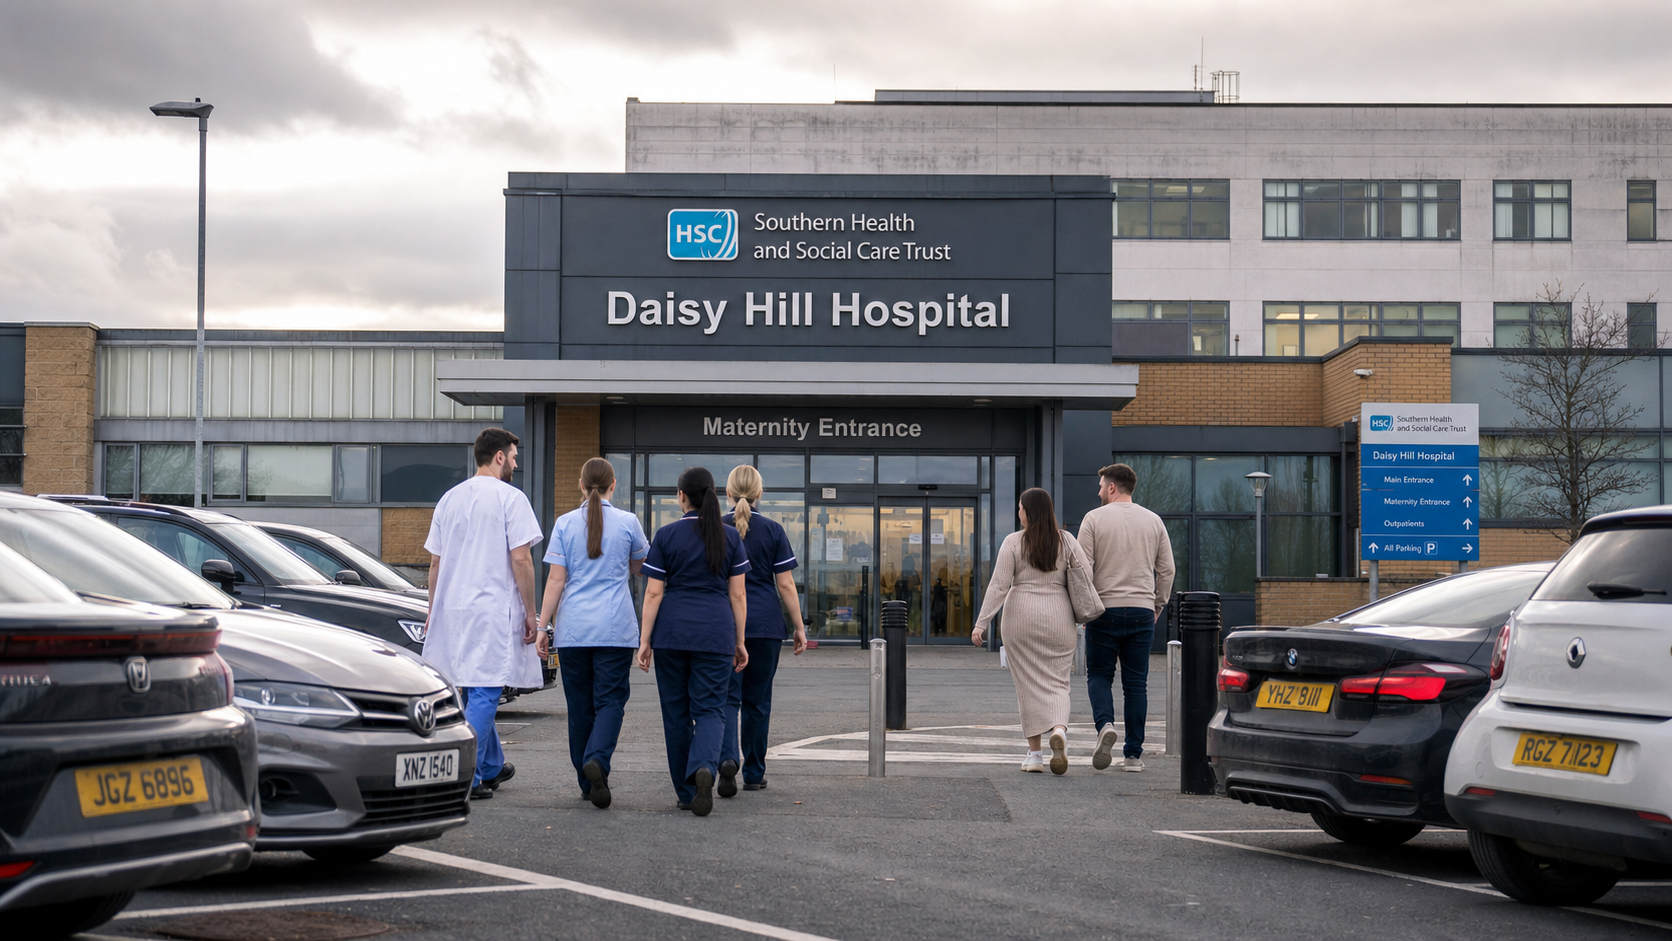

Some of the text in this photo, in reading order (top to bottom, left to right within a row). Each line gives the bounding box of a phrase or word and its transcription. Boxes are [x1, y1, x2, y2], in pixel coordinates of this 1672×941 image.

[754, 213, 915, 231] Southern Health
[676, 224, 722, 243] HSC
[754, 241, 951, 260] and Social Care Trust
[607, 291, 1010, 335] Daisy Hill Hospital
[703, 417, 922, 441] Maternity Entrance
[1372, 419, 1389, 427] HSC
[1373, 451, 1454, 462] Daisy Hill Hospital
[1404, 476, 1434, 484] Entrance
[1384, 498, 1450, 507] Maternity Entrance
[1384, 520, 1424, 528] Outpatients
[1396, 544, 1421, 553] Parking
[1267, 684, 1295, 705] YHZ
[1521, 738, 1557, 762] RGZ
[403, 754, 453, 781] XNZ 1540
[93, 765, 195, 806] JGZ 6896
